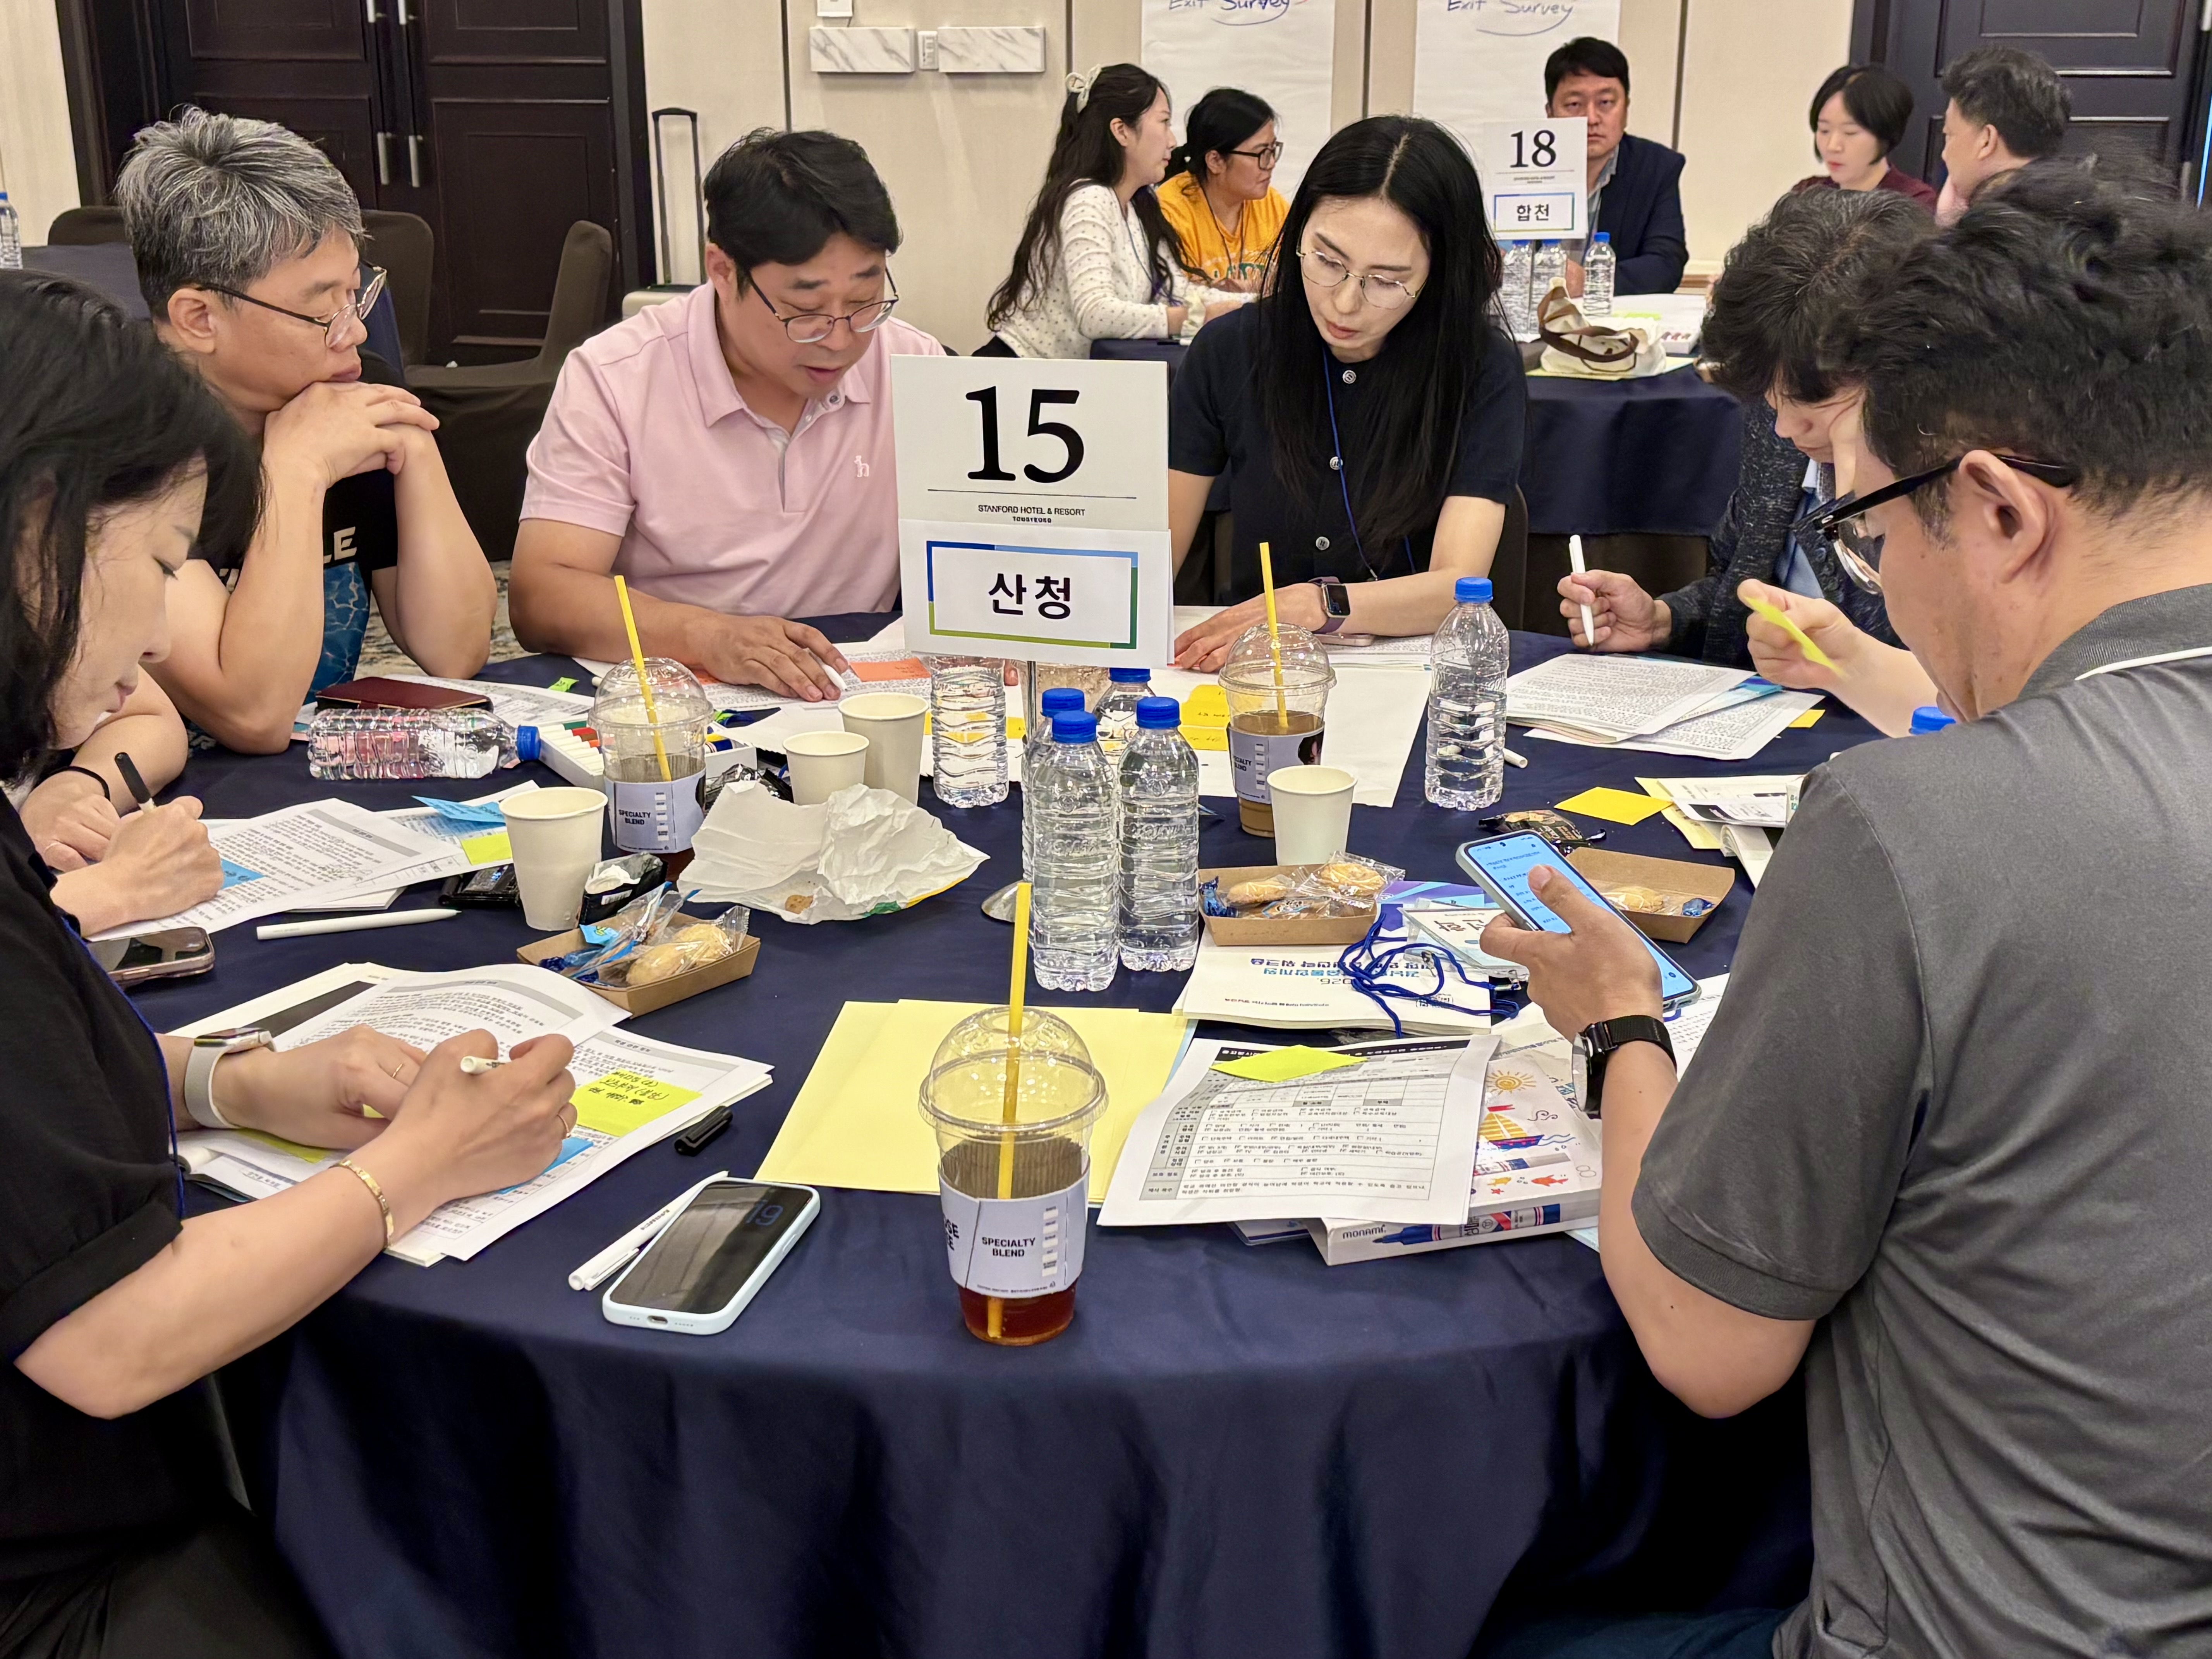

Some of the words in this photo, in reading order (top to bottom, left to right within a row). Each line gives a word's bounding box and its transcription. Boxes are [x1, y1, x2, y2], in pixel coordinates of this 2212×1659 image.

[1448, 0, 1488, 11] Exit
[1510, 129, 1556, 168] 18
[1516, 204, 1549, 222] 합천
[965, 386, 1085, 484] 15
[978, 505, 1018, 513] STANFORD
[1054, 508, 1085, 516] RESORT
[988, 573, 1072, 620] 산청
[618, 809, 651, 818] SPECIALTY
[625, 817, 645, 825] BLEND
[1342, 1224, 1387, 1240] monami
[982, 1237, 1036, 1248] SPECIALTY
[992, 1248, 1025, 1258] BLEND
